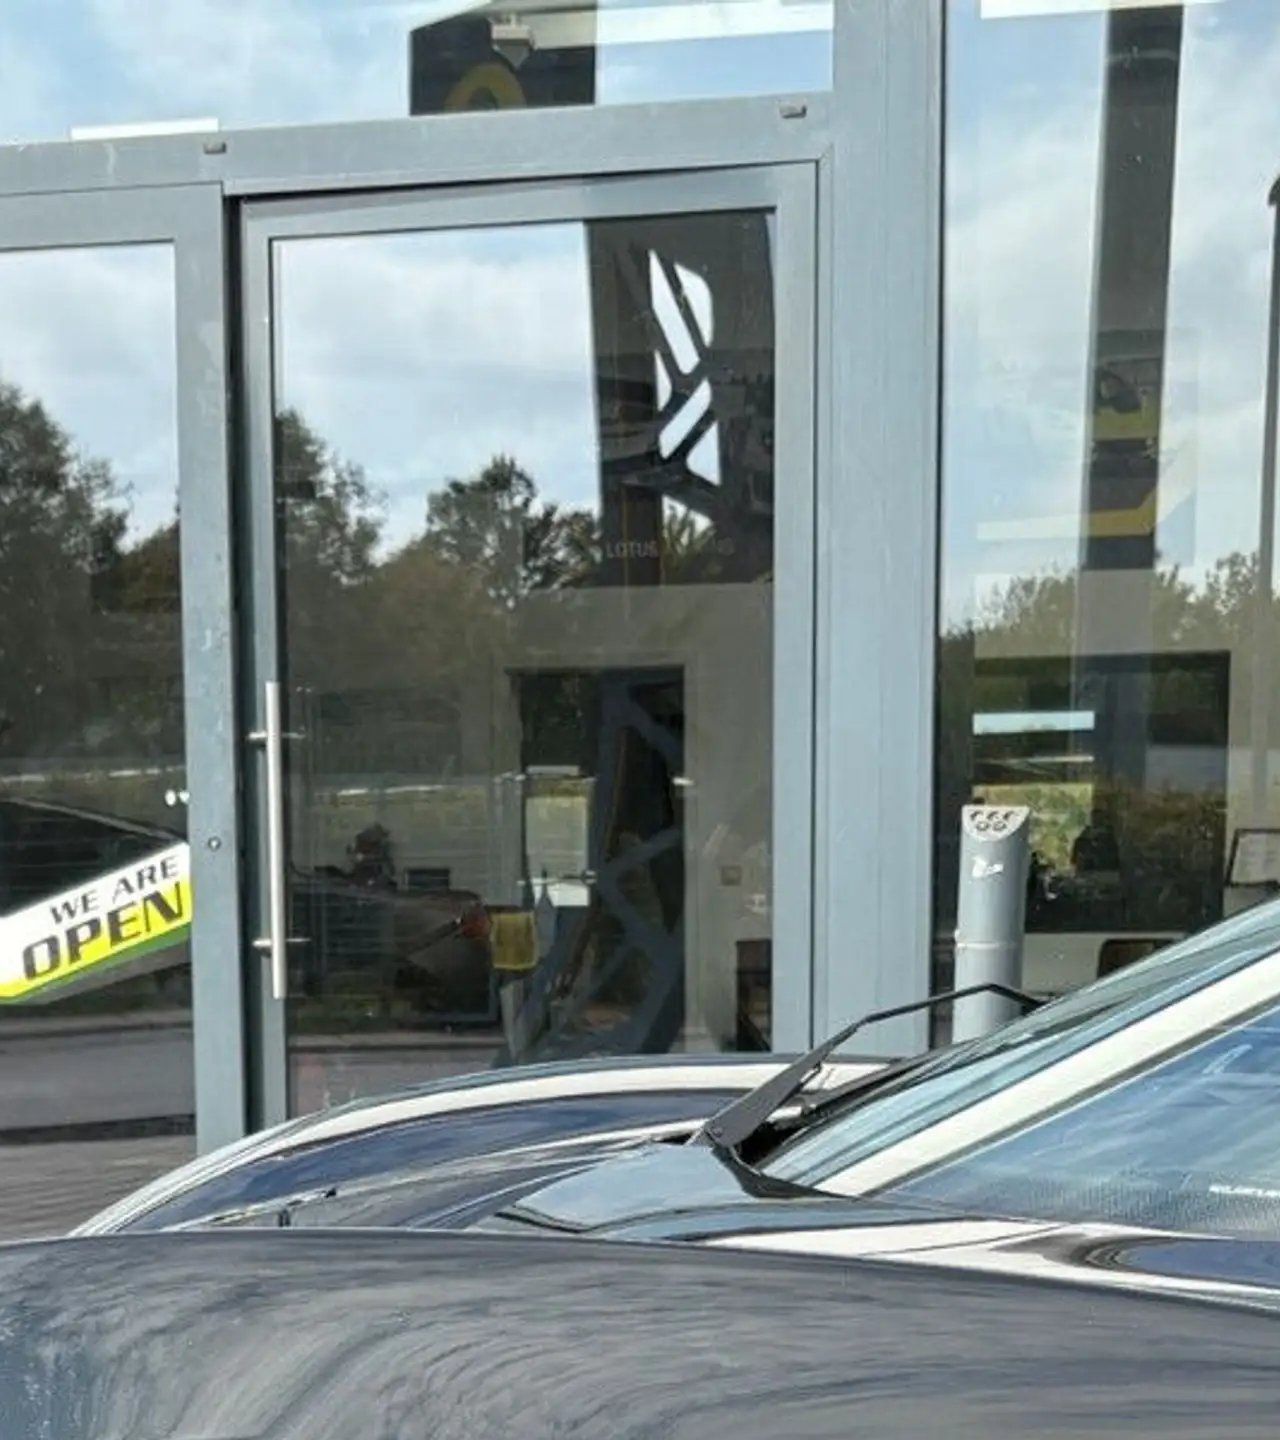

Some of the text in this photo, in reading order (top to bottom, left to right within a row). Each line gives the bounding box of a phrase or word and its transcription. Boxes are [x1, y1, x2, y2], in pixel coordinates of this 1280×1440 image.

[22, 880, 184, 981] OPEN
[50, 853, 180, 925] WE ARE
